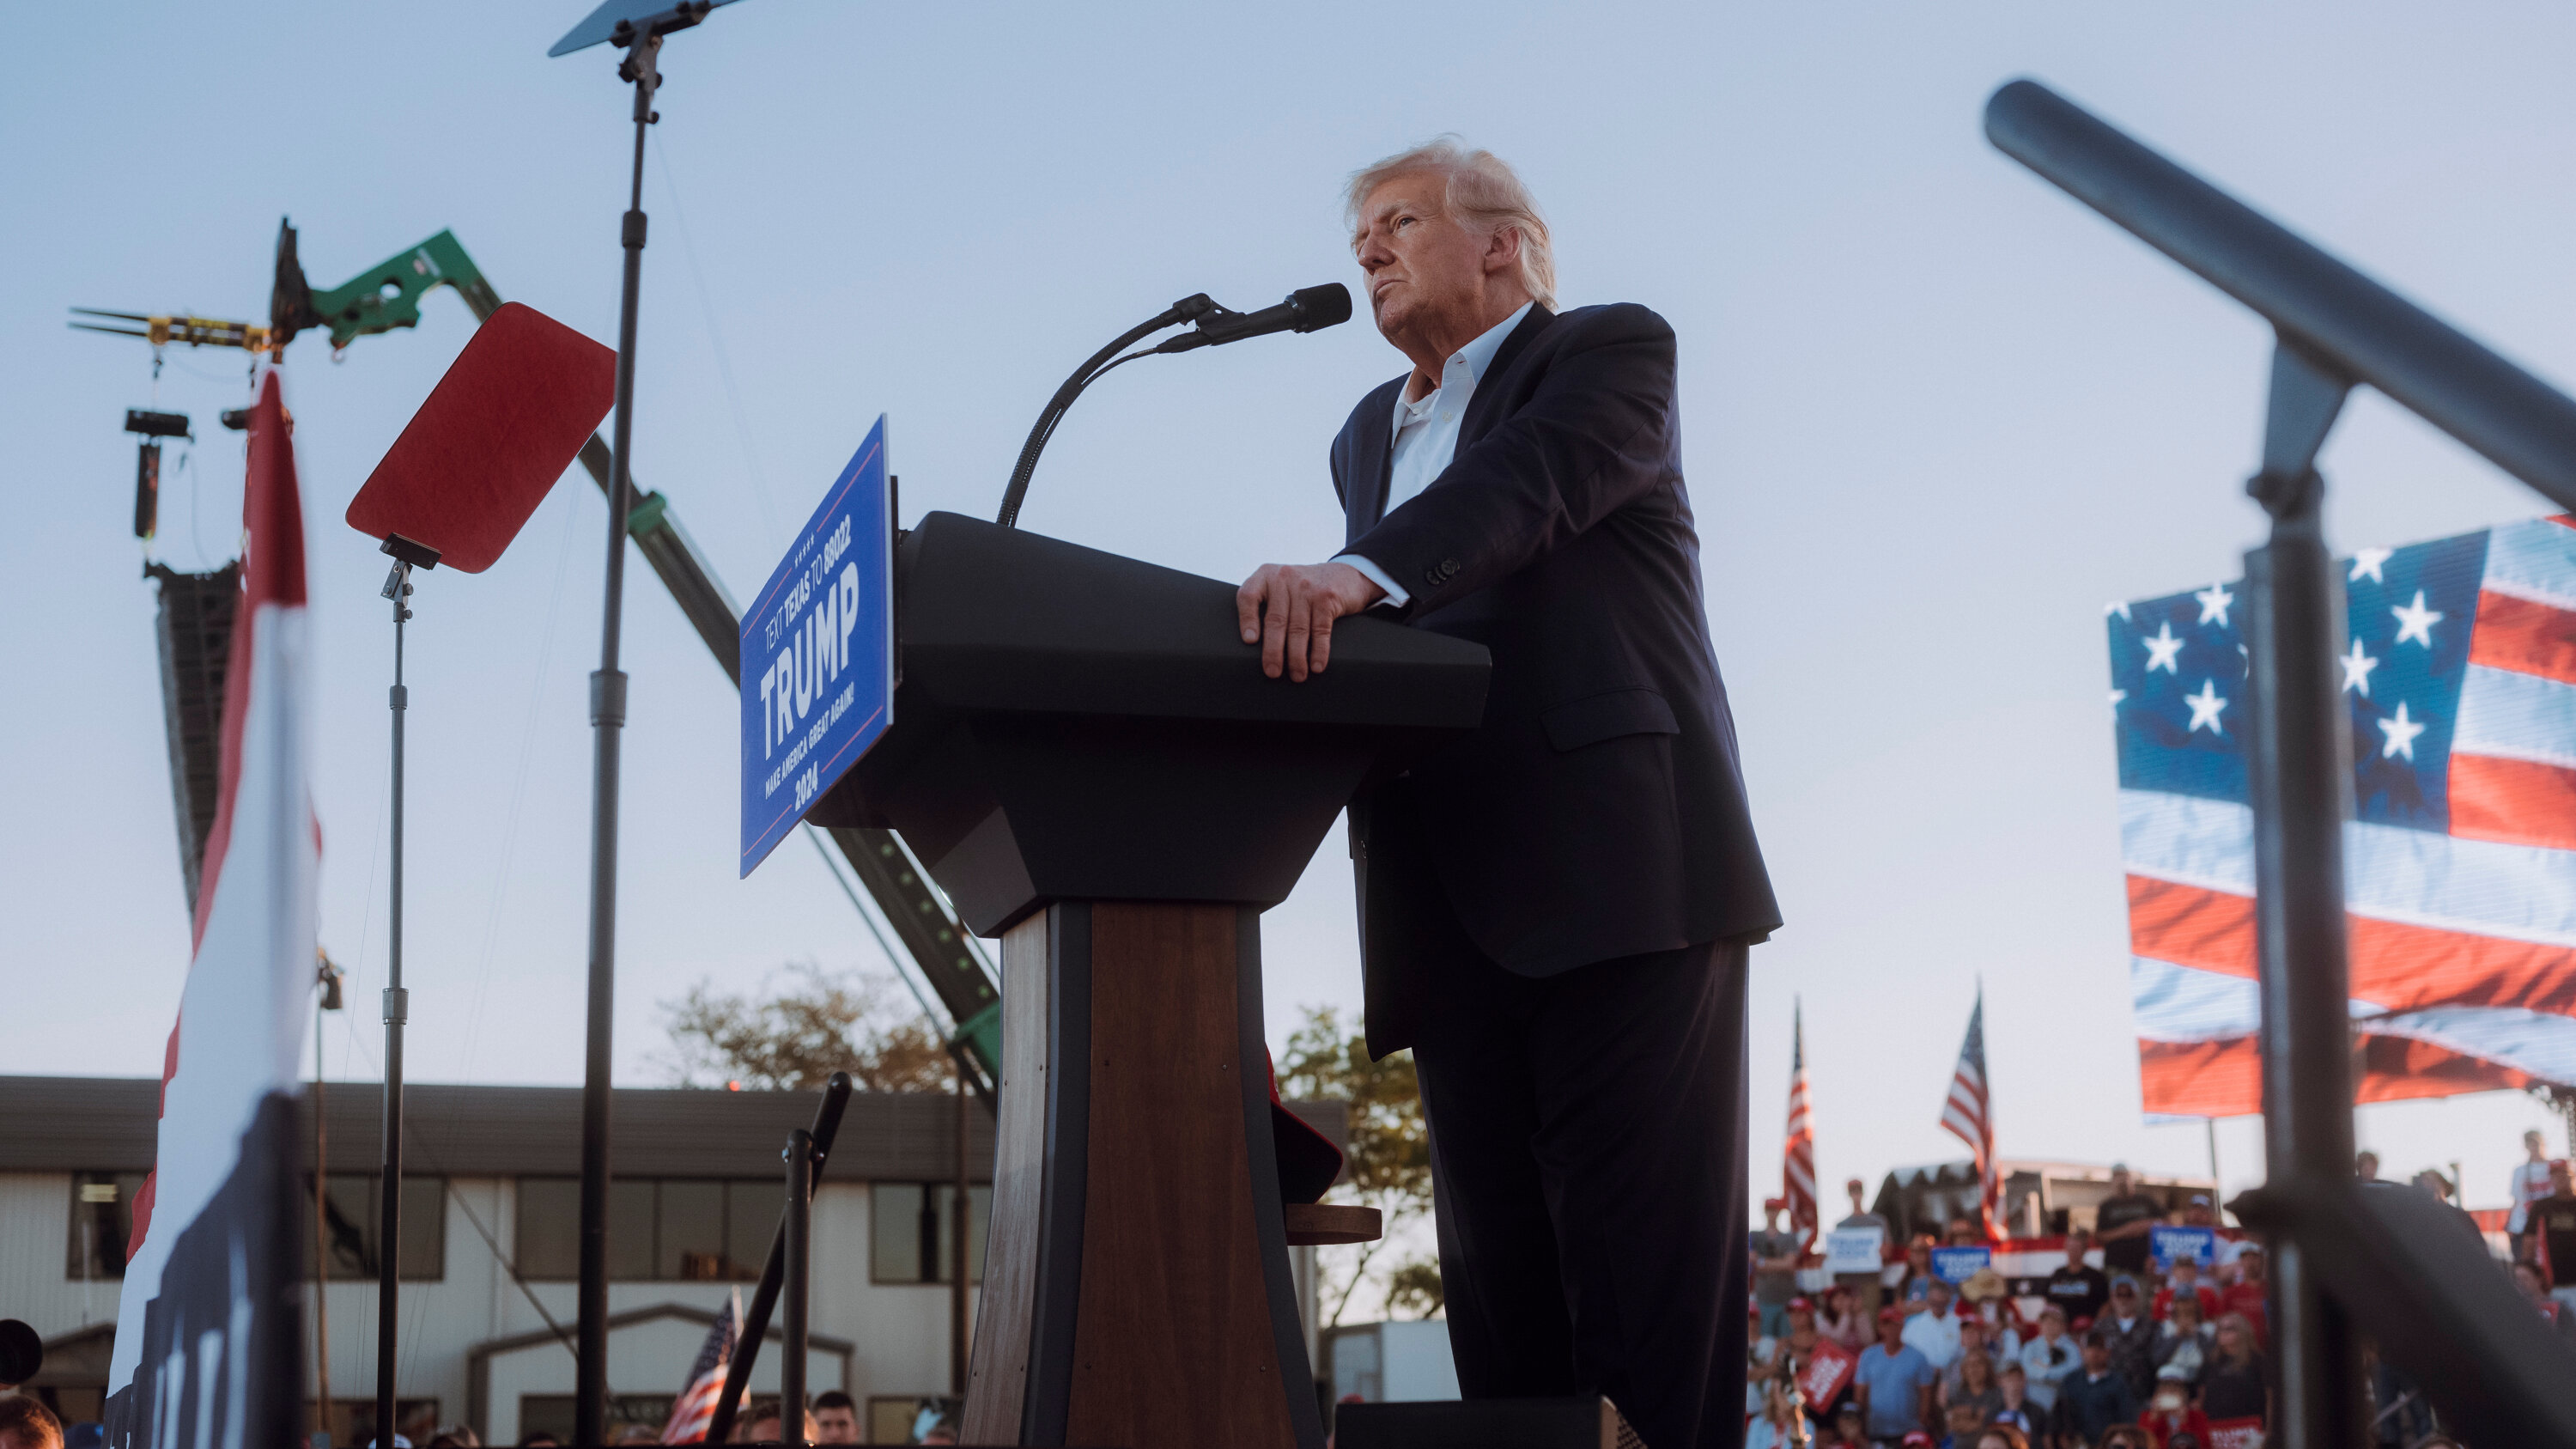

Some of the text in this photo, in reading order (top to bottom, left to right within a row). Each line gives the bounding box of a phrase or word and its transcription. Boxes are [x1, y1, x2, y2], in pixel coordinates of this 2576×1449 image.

[765, 514, 852, 654] TEXT TEXAS TO 88022
[760, 561, 859, 761] TRUMP
[765, 681, 854, 801] MAKE AMERICA GREAT AGAIN!
[794, 760, 818, 812] 2024
